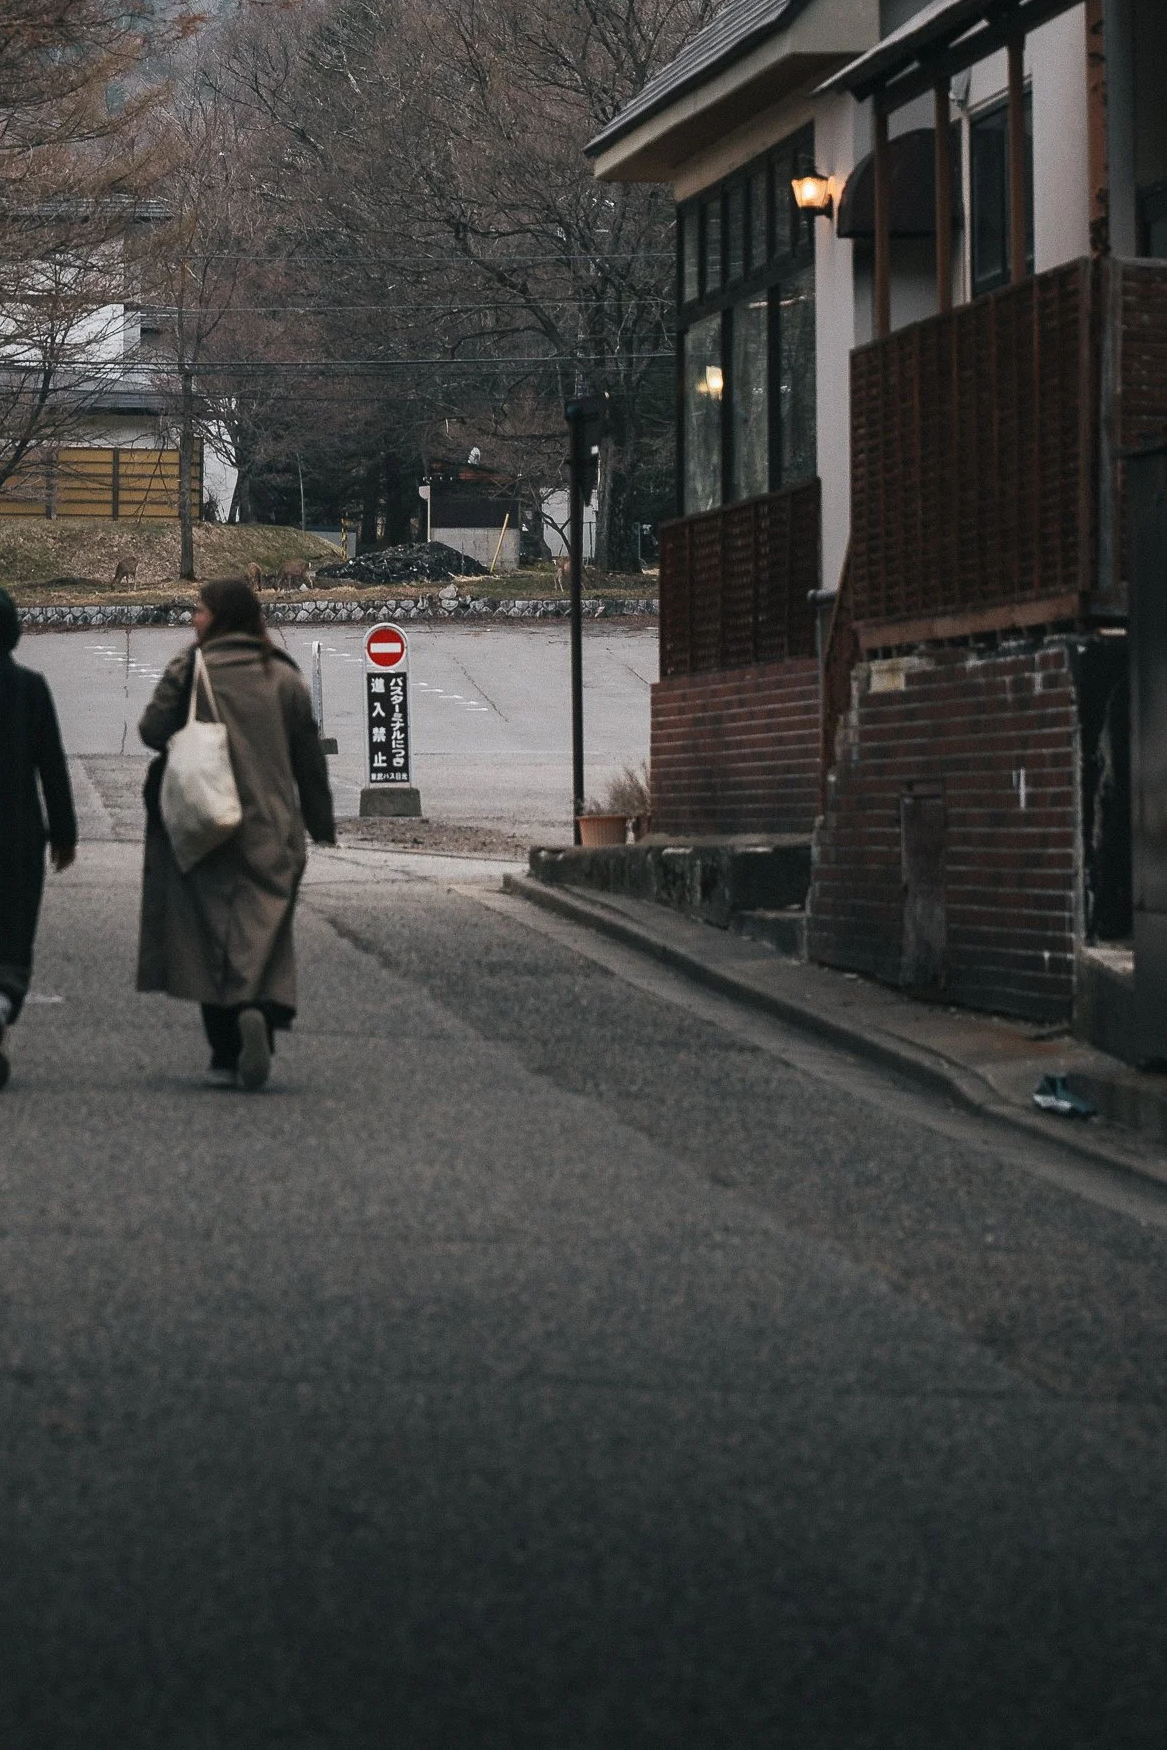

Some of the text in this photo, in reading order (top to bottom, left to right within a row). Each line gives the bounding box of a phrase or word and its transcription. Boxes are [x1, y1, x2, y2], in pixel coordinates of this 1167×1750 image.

[371, 677, 387, 767] 進入禁止
[390, 677, 405, 767] バスターミナルにつき
